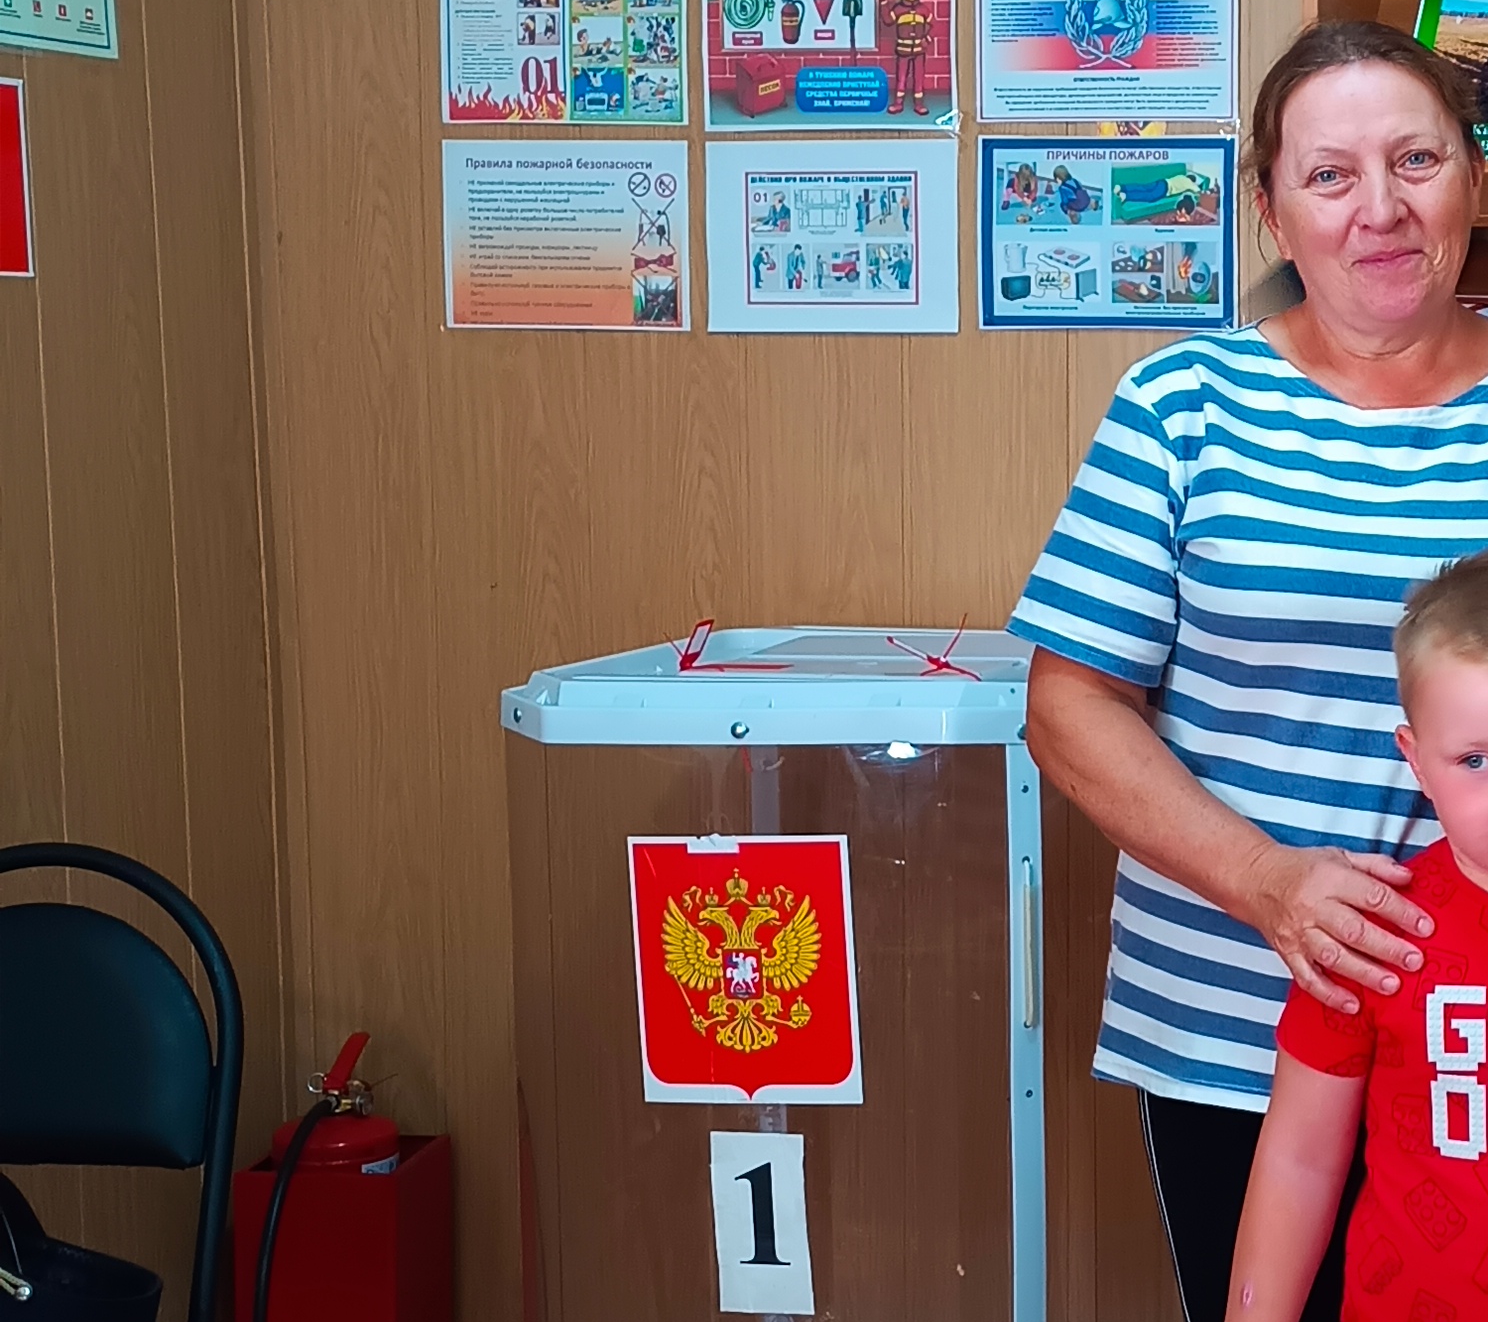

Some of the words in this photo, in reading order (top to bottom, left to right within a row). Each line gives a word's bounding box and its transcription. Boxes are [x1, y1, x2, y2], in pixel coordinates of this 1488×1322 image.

[521, 56, 559, 95] 01
[1047, 151, 1105, 160] ПРИЧИНЫ
[1109, 151, 1169, 160] ПОЖАРОВ
[466, 158, 513, 171] Правила
[516, 158, 572, 171] пожарной
[576, 158, 652, 170] безопасности
[754, 192, 767, 203] 01
[734, 1161, 791, 1267] 1
